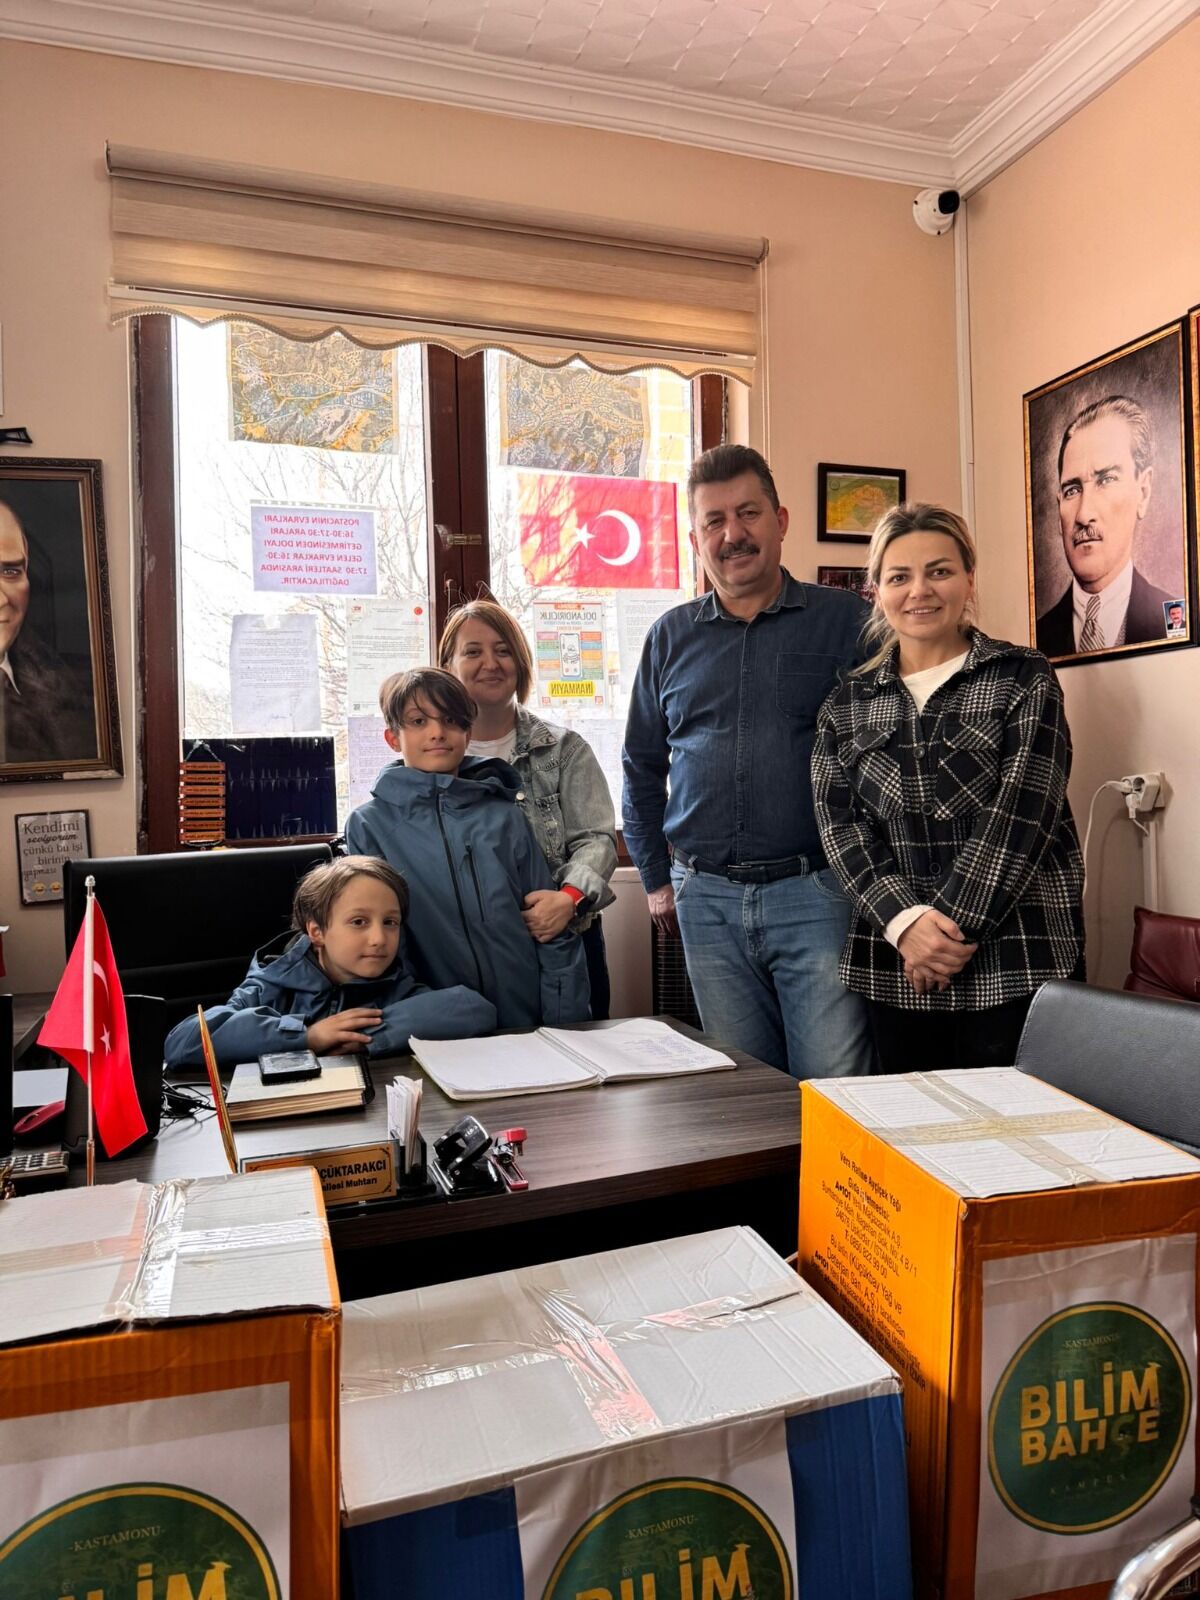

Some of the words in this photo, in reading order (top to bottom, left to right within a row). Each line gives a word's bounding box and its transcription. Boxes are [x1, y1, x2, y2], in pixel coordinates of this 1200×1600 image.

[24, 820, 80, 835] Kendimi
[26, 834, 78, 844] seviyorum
[23, 845, 54, 857] çünkü
[56, 844, 70, 853] bu
[72, 842, 83, 853] işi
[318, 1160, 386, 1181] ÇÜKTARAKCI
[345, 1177, 377, 1188] Muhtarı
[881, 1282, 892, 1307] Yağ
[894, 1299, 901, 1314] ve
[1020, 1361, 1161, 1430] BILİM
[1021, 1408, 1160, 1466] BAHÇE
